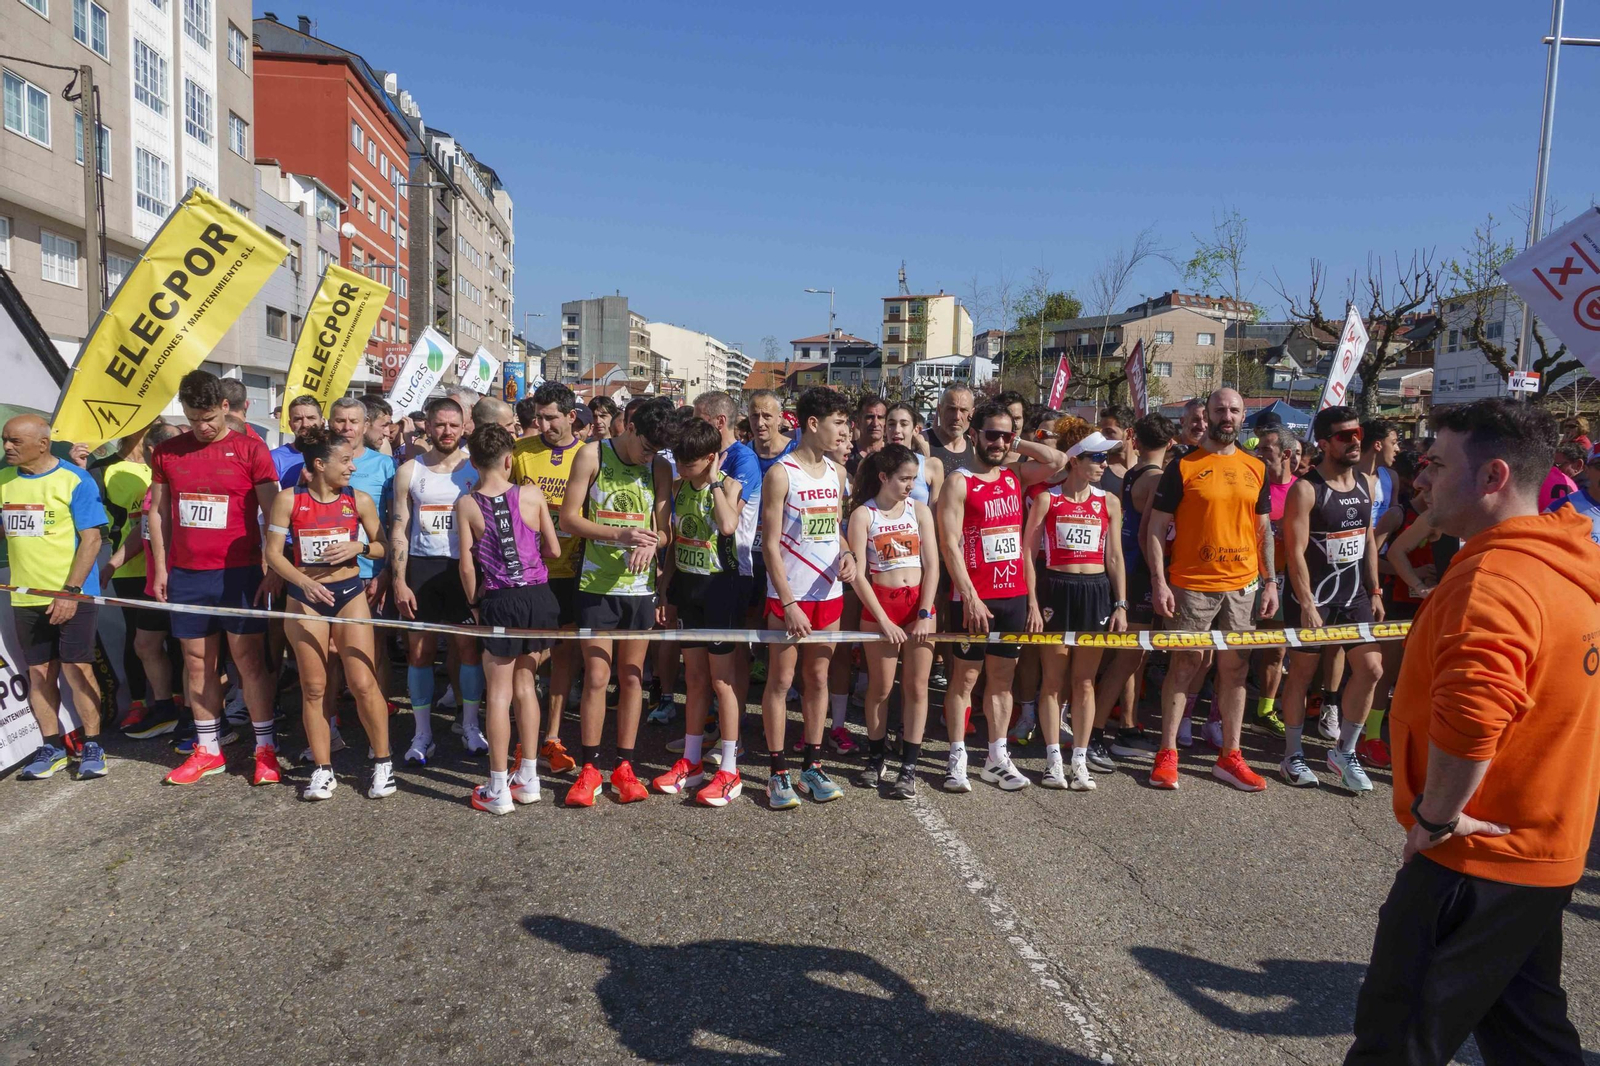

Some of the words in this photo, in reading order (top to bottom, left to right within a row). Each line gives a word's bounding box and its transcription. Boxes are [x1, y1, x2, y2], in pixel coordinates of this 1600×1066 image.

[105, 222, 238, 388] ELECPOR
[137, 333, 184, 399] INSTALACIONES
[180, 325, 189, 334] Y
[187, 259, 243, 328] MANTENIMIENTO
[241, 245, 256, 260] S.L.
[302, 282, 360, 393] ELECPOR
[323, 354, 343, 398] INSTALACIONES
[342, 300, 366, 349] MANTENIMIENTO
[416, 373, 435, 405] energy
[1513, 378, 1525, 388] WC
[797, 488, 838, 501] TREGA
[1339, 497, 1361, 505] VOLTA
[190, 505, 213, 522] 701
[7, 515, 35, 530] 1054
[432, 515, 453, 530] 419
[809, 517, 836, 535] 2228
[878, 522, 913, 533] TREGA
[1341, 518, 1363, 528] Kiroot
[1066, 528, 1092, 545] 435
[994, 537, 1017, 554] 436
[1338, 540, 1359, 557] 455
[678, 547, 705, 568] 2203
[1077, 633, 1139, 647] GADIS
[1152, 632, 1213, 647] GADIS
[1225, 630, 1287, 645] GADIS
[1299, 626, 1360, 642] GADIS
